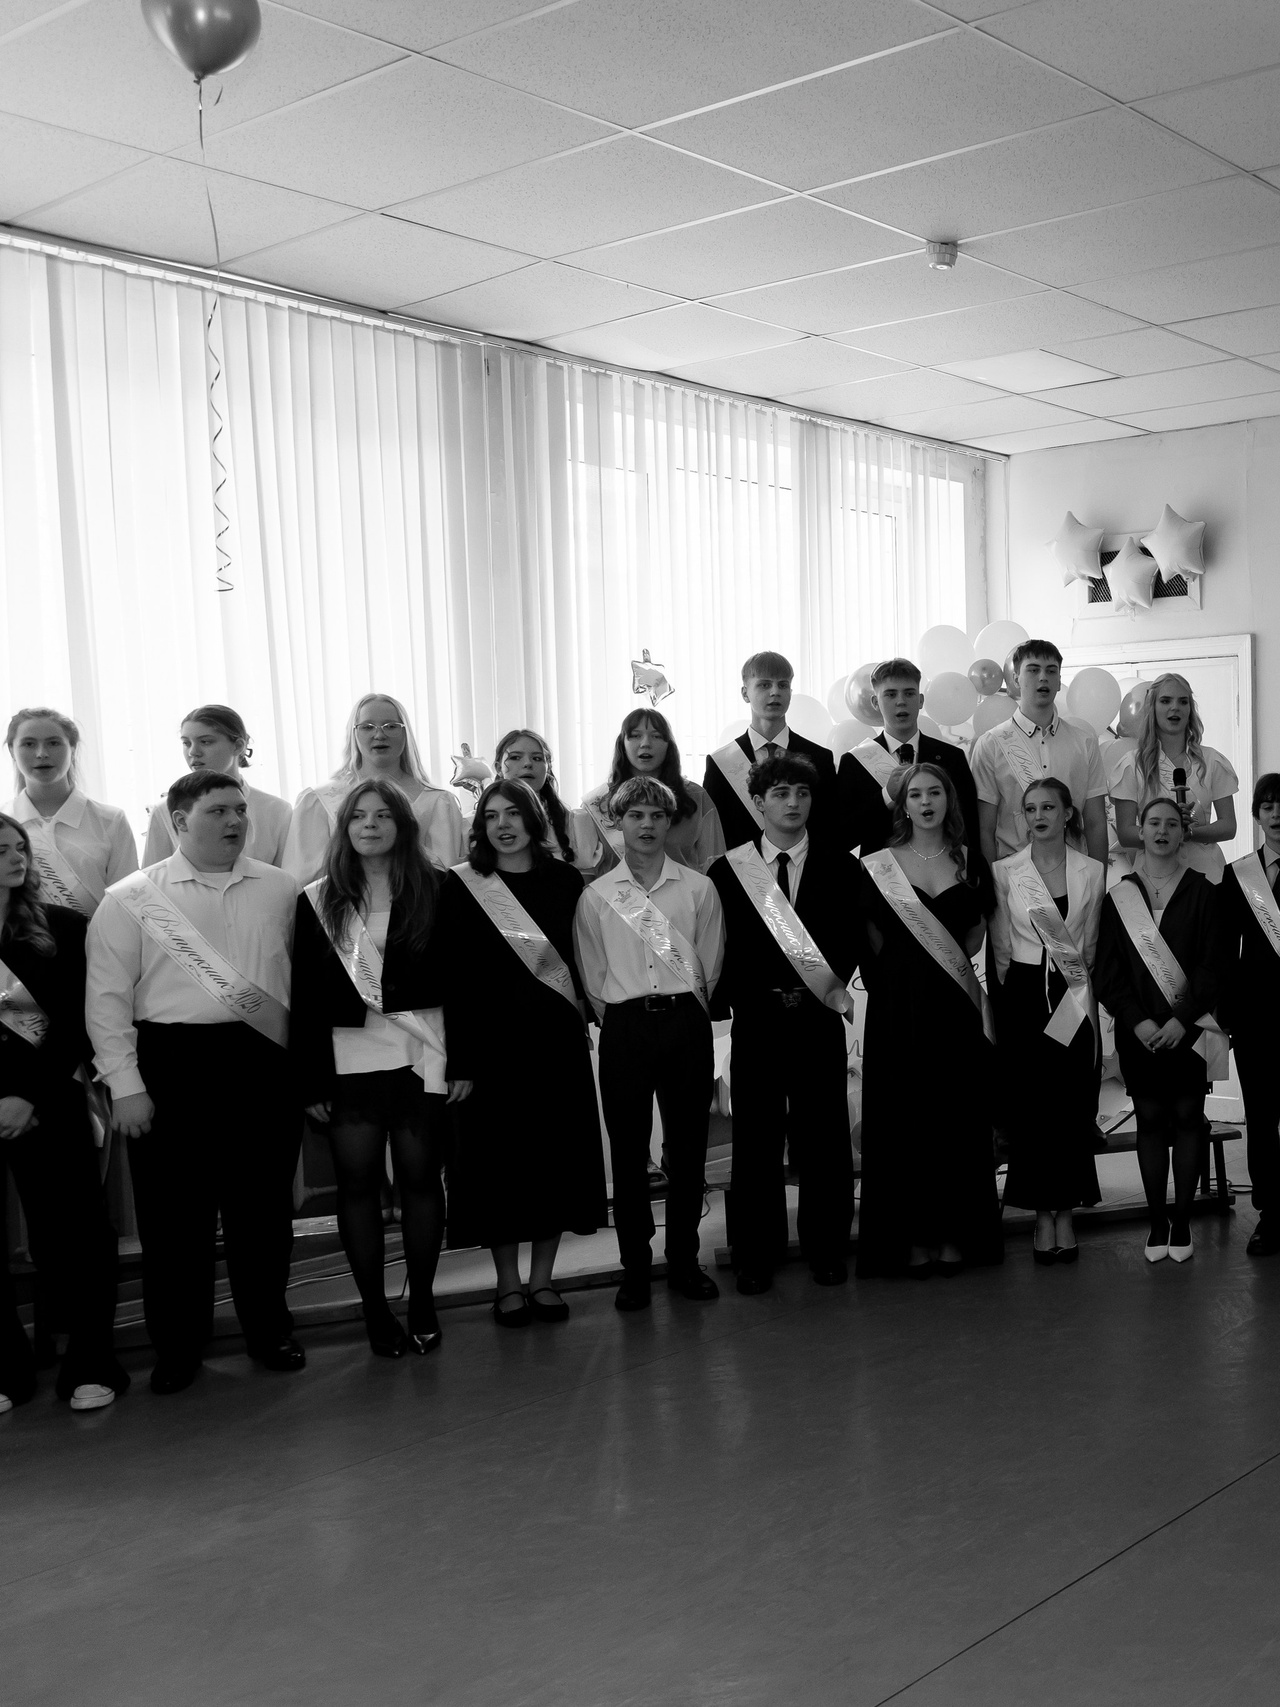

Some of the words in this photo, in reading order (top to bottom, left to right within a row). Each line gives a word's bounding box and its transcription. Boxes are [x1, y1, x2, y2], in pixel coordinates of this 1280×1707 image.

[140, 904, 235, 990] Выпускник
[226, 987, 268, 1014] 2026
[1063, 958, 1087, 982] 2026
